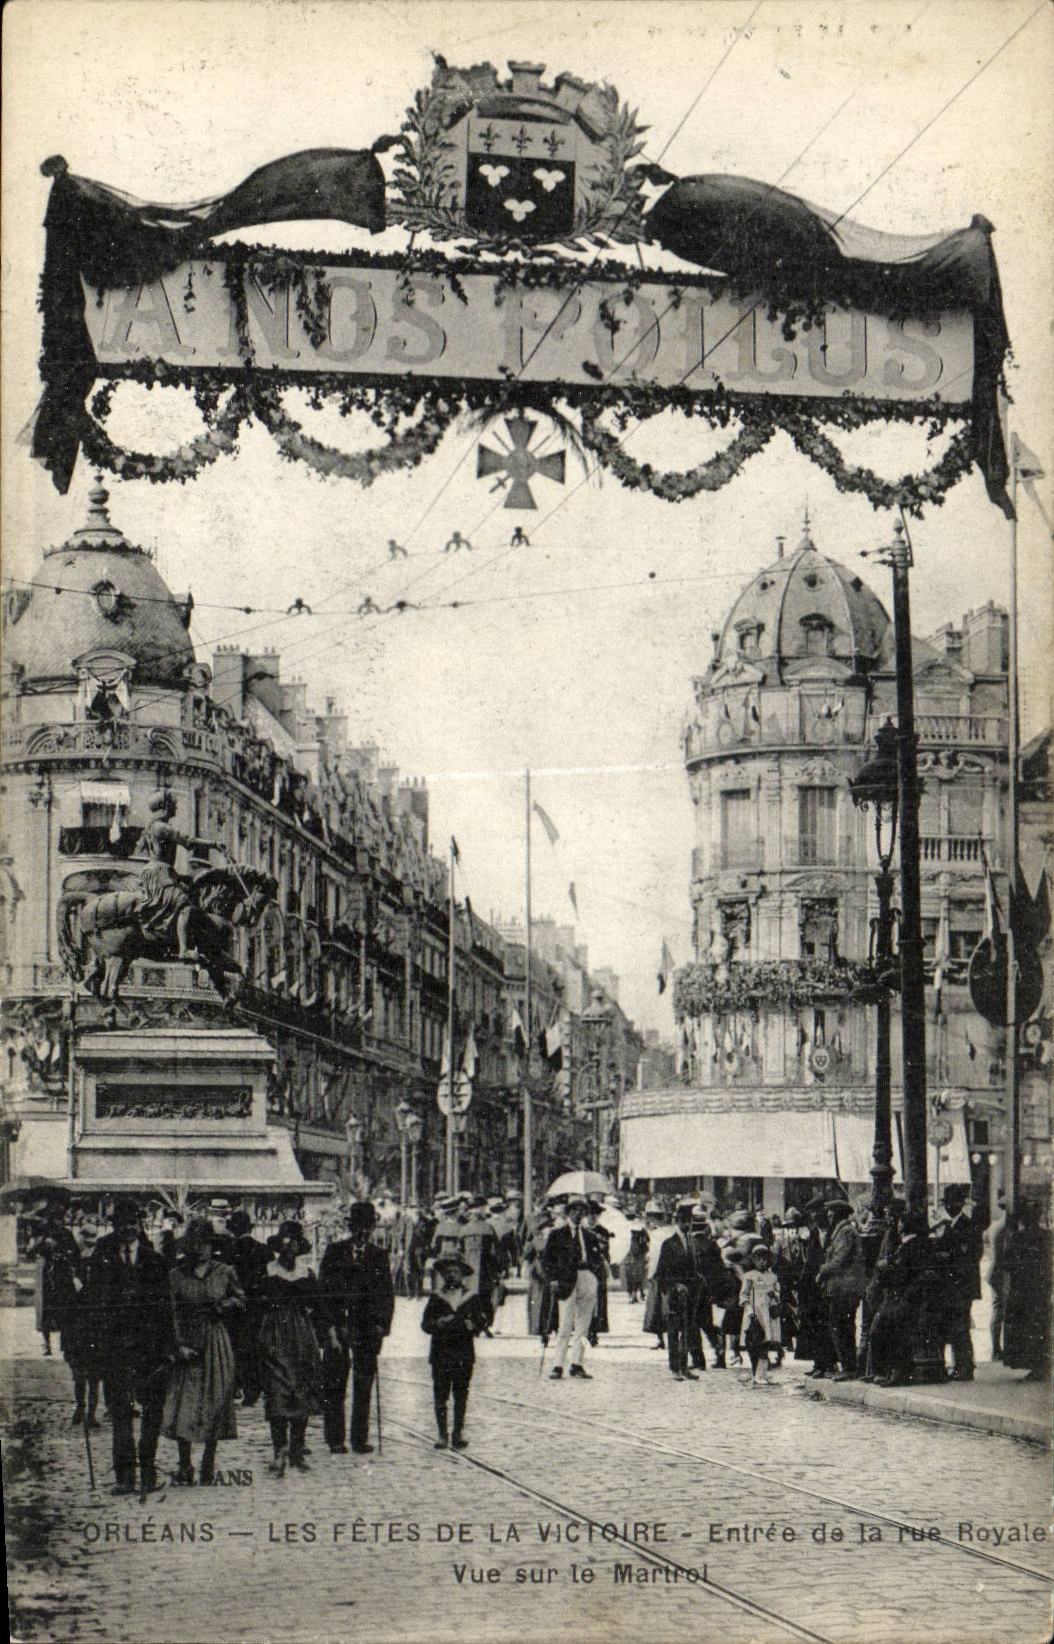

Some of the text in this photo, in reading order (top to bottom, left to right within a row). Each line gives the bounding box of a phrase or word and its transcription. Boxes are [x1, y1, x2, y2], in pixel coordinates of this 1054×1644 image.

[99, 268, 945, 389] A NOS POILUS
